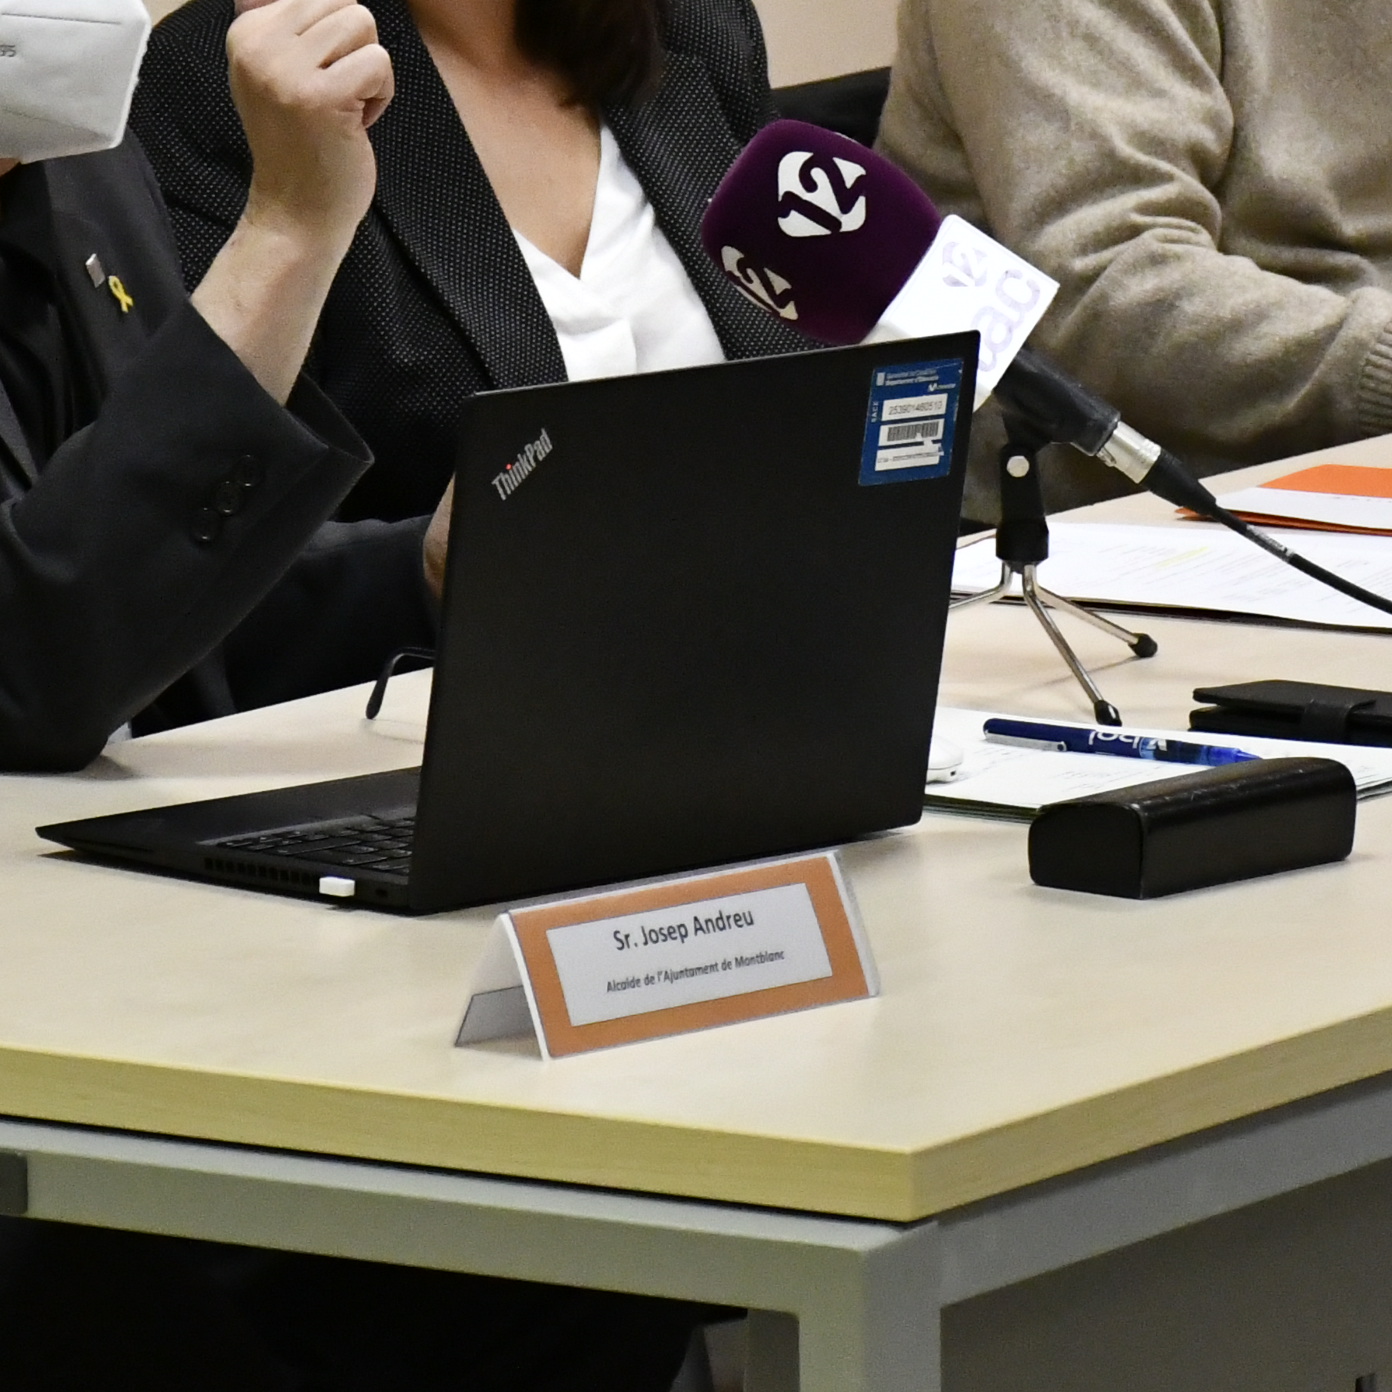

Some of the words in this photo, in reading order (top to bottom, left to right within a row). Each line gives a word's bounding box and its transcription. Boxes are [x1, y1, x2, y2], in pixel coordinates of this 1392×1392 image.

[491, 427, 554, 501] ThinkPad
[613, 930, 638, 951] Sr.
[641, 923, 689, 946] Josep
[693, 910, 754, 936] Andreu
[643, 973, 655, 986] de
[721, 958, 732, 971] de
[734, 951, 785, 968] Montblanc
